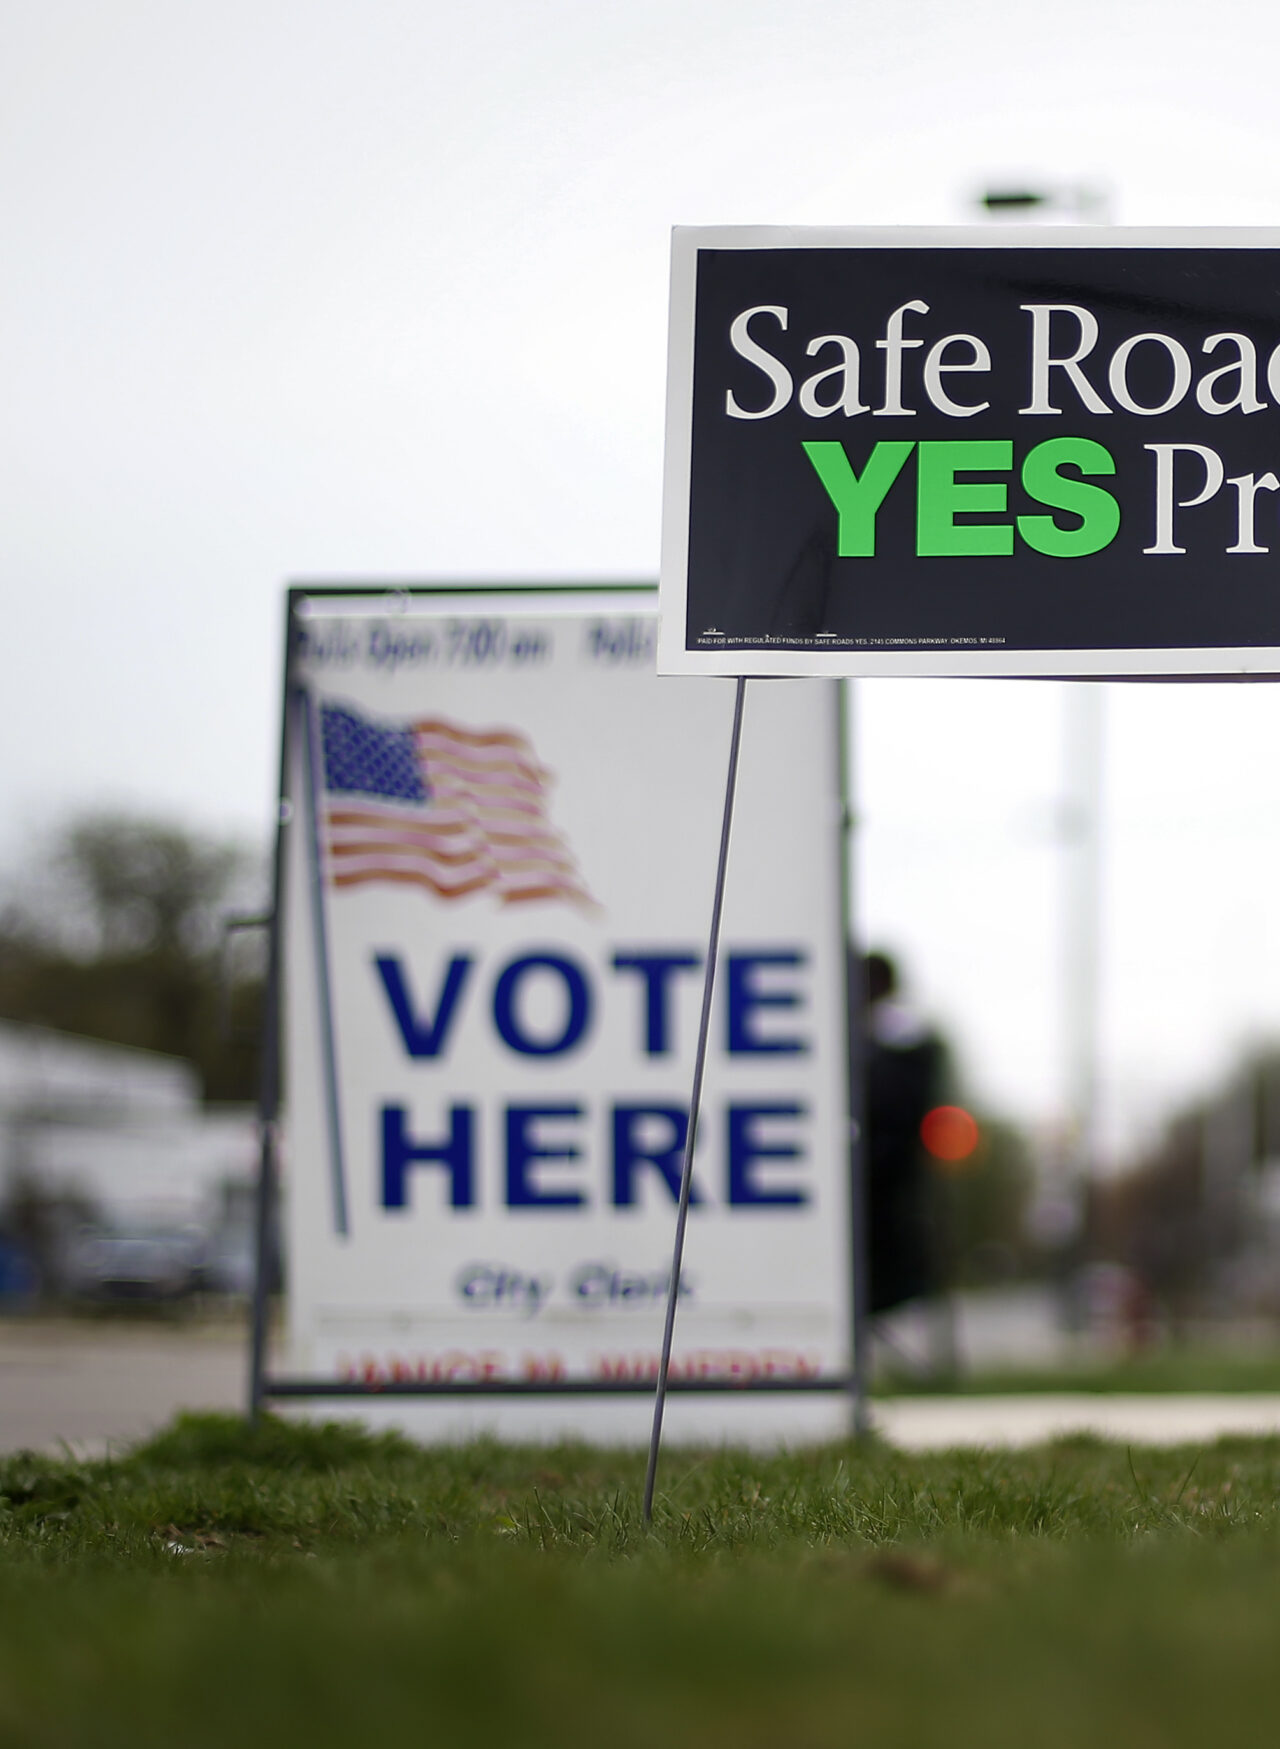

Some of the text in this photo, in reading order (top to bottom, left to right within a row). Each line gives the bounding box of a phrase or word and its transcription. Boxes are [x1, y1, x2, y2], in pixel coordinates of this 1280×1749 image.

[726, 300, 992, 419] Safe
[802, 437, 1121, 558] YES
[744, 636, 782, 644] REGULATED
[782, 637, 803, 645] FUNDS
[373, 951, 809, 1058] VOTE
[379, 1103, 809, 1210] HERE
[457, 1262, 553, 1318] City
